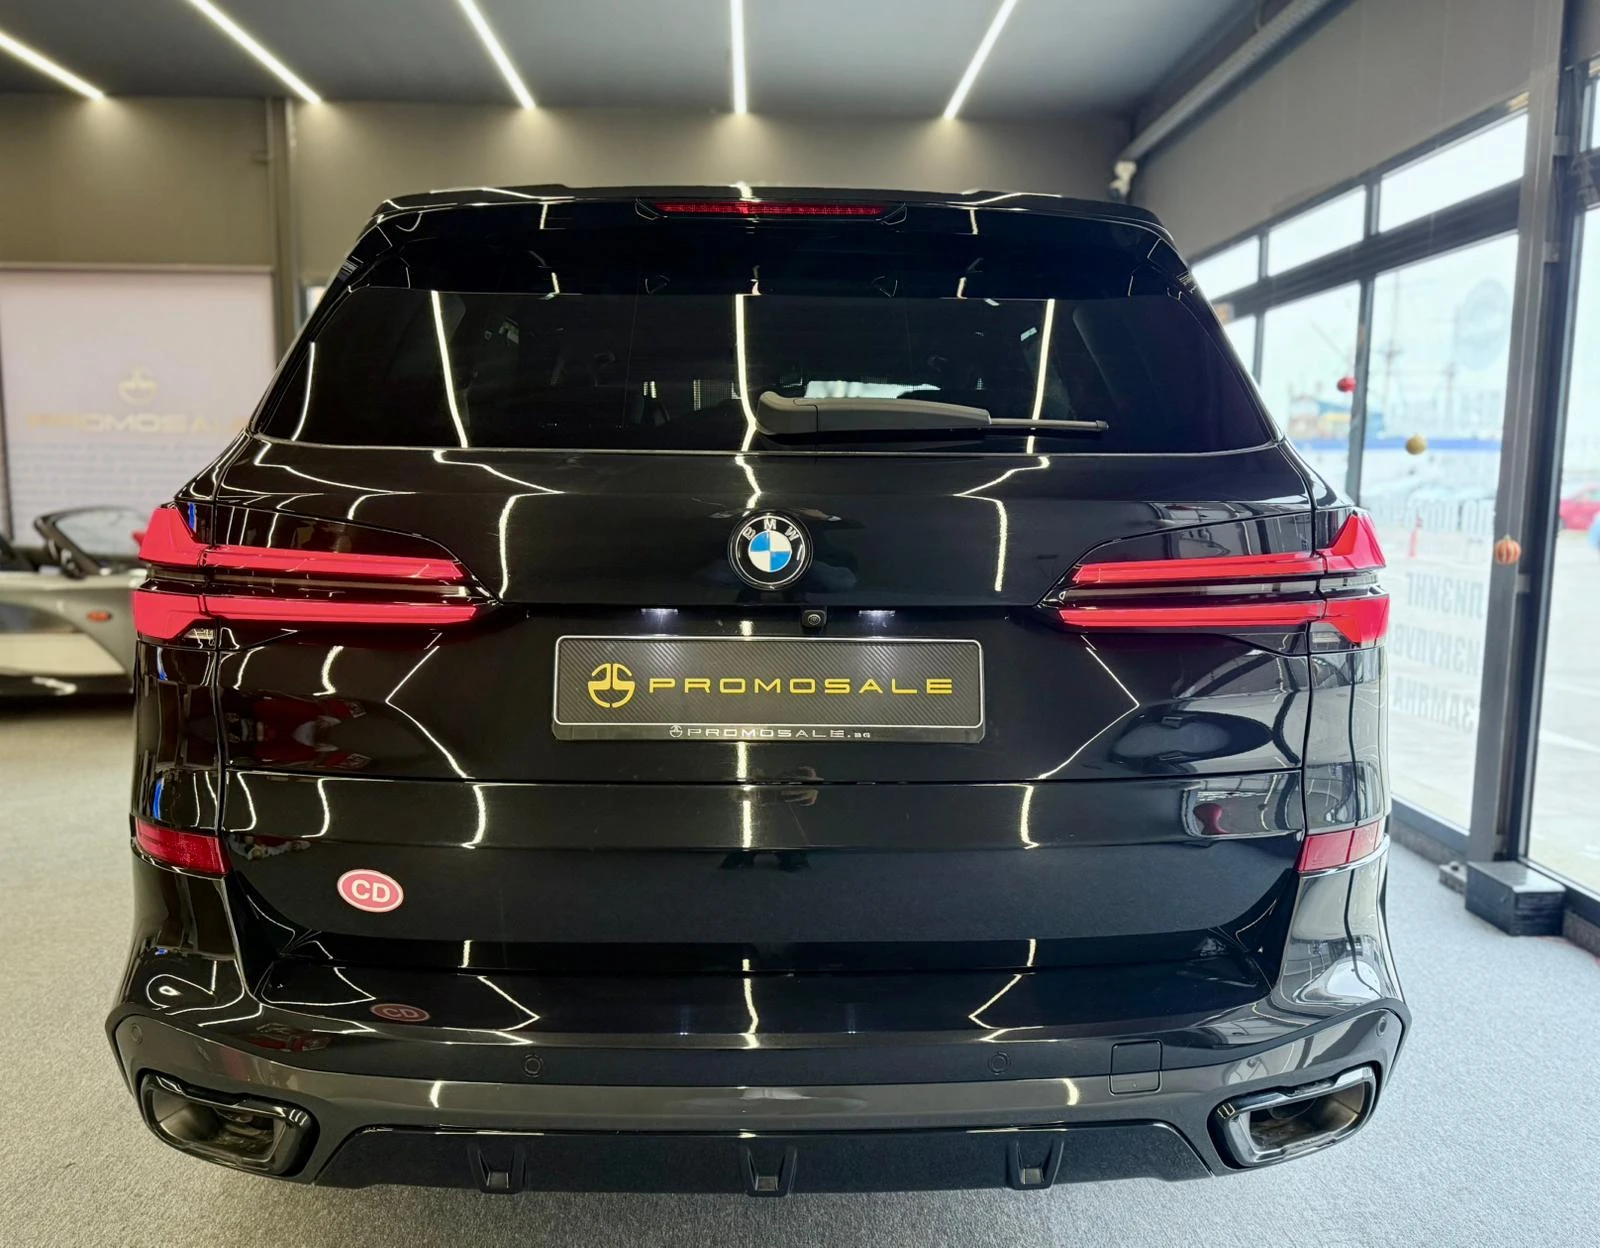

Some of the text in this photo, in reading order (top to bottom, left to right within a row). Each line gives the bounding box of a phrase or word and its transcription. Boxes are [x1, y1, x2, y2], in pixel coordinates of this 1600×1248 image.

[742, 518, 800, 542] BMW
[648, 676, 953, 695] PROMOSALE
[351, 878, 391, 903] CD
[383, 1007, 418, 1019] CD
